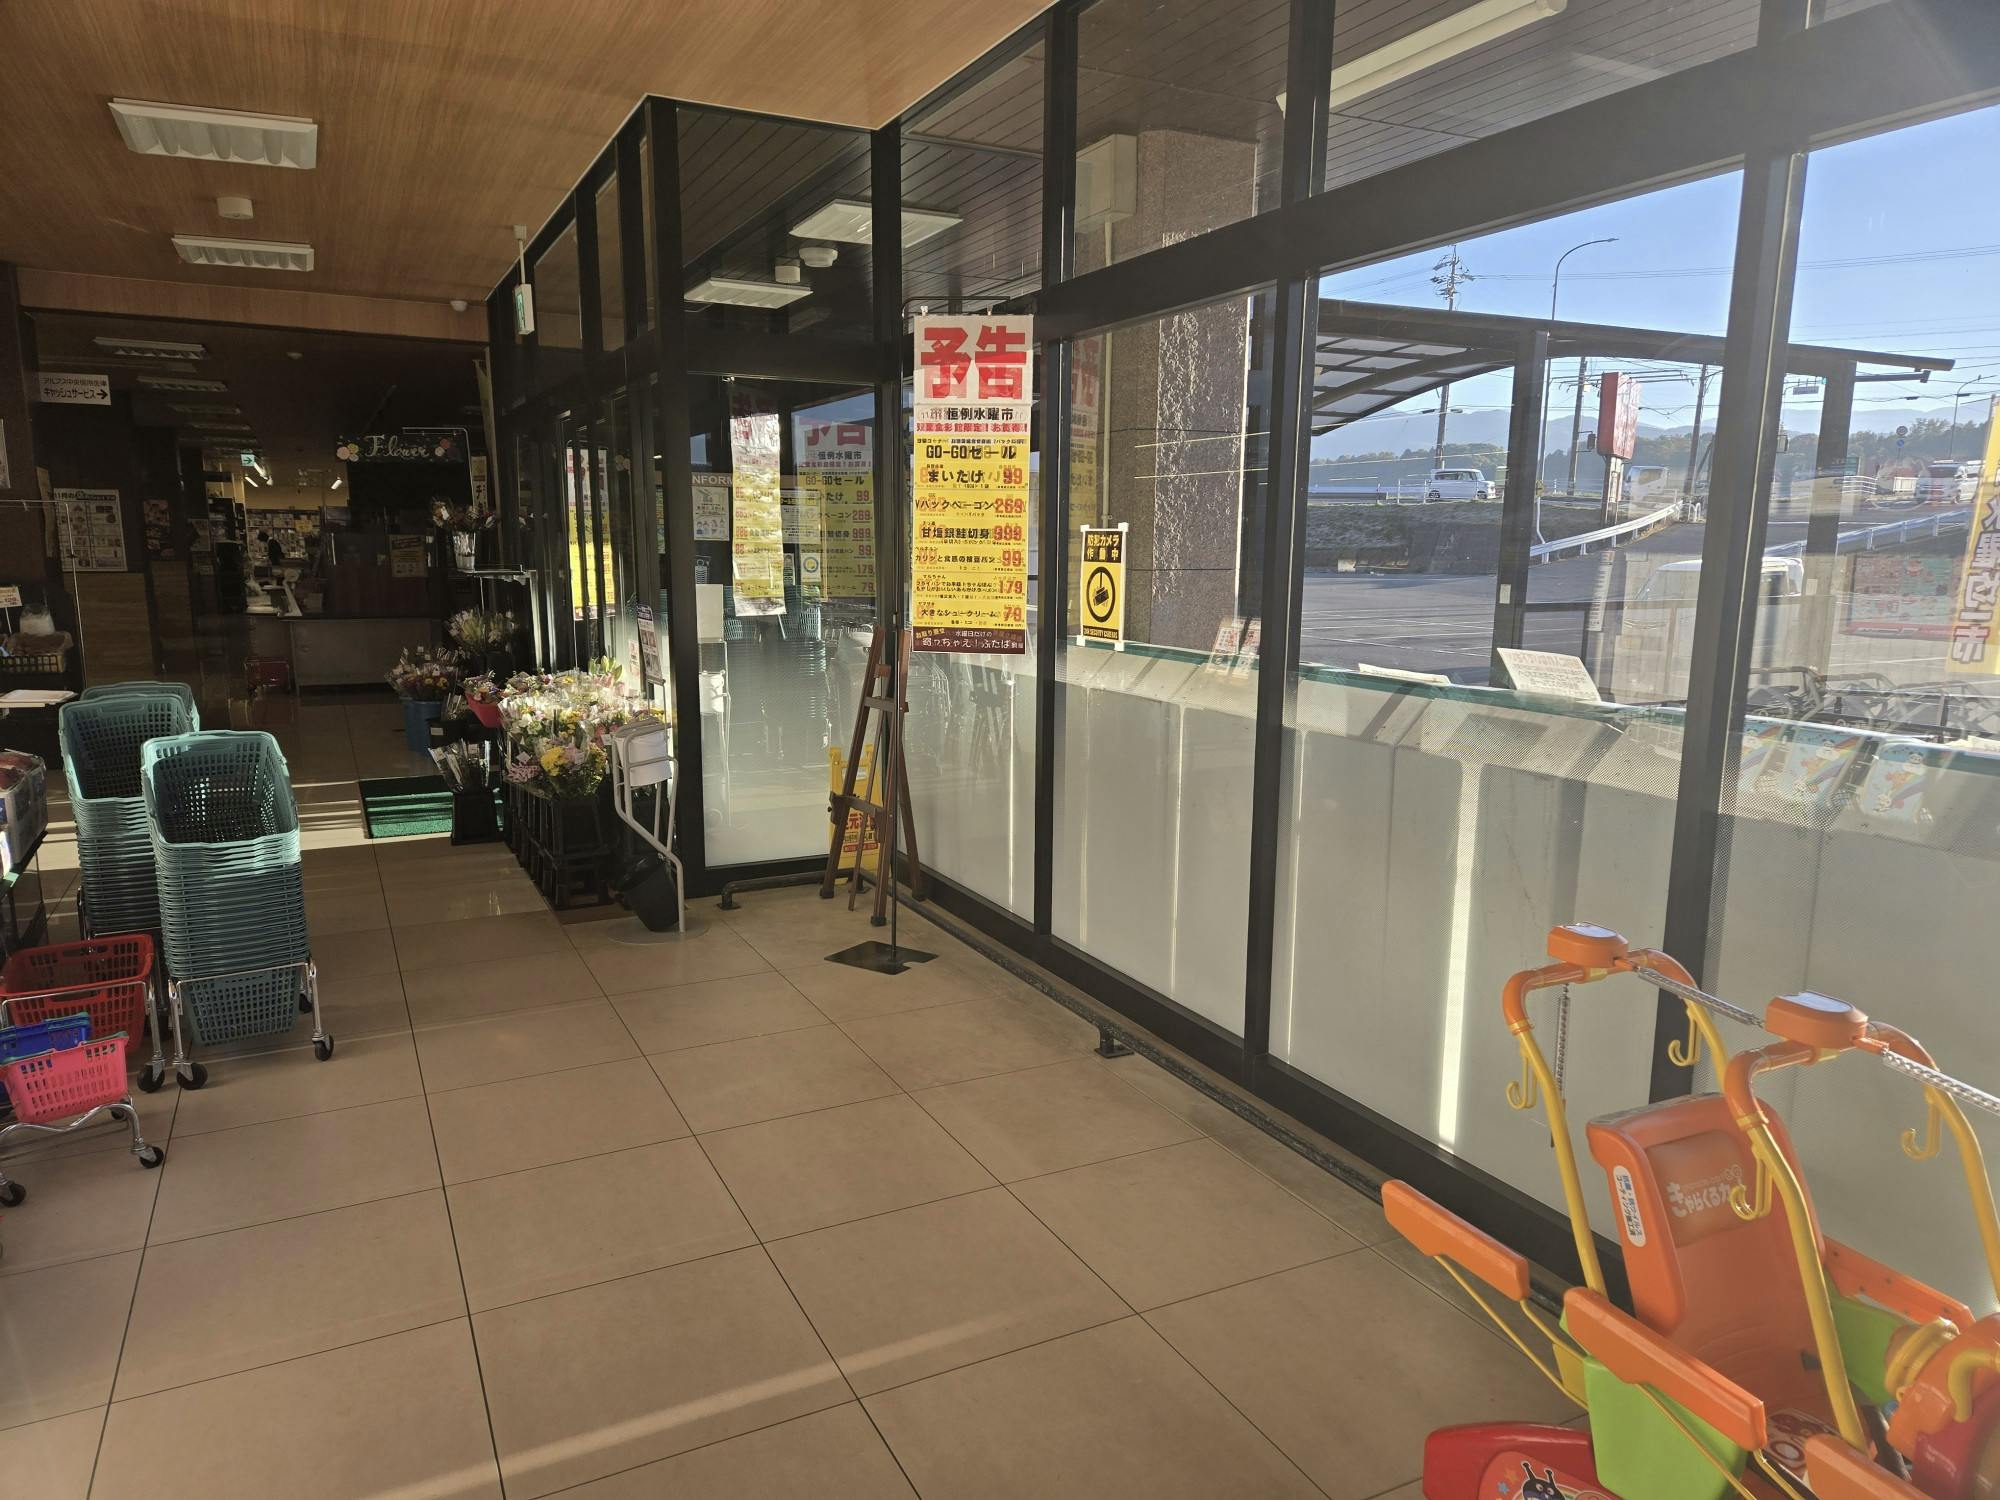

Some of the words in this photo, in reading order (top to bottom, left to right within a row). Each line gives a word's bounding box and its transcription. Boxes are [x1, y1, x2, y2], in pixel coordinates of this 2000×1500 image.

[919, 324, 1028, 401] 予告
[44, 388, 97, 400] キャッシュサービス
[947, 407, 1014, 421] 恒例水曜市
[364, 434, 430, 458] Flower
[927, 469, 984, 483] まいたけ
[921, 527, 990, 539] 甘塩銀鮭切身
[1087, 534, 1120, 548] 防犯カメラ
[921, 608, 996, 619] 大きなシュークリーム
